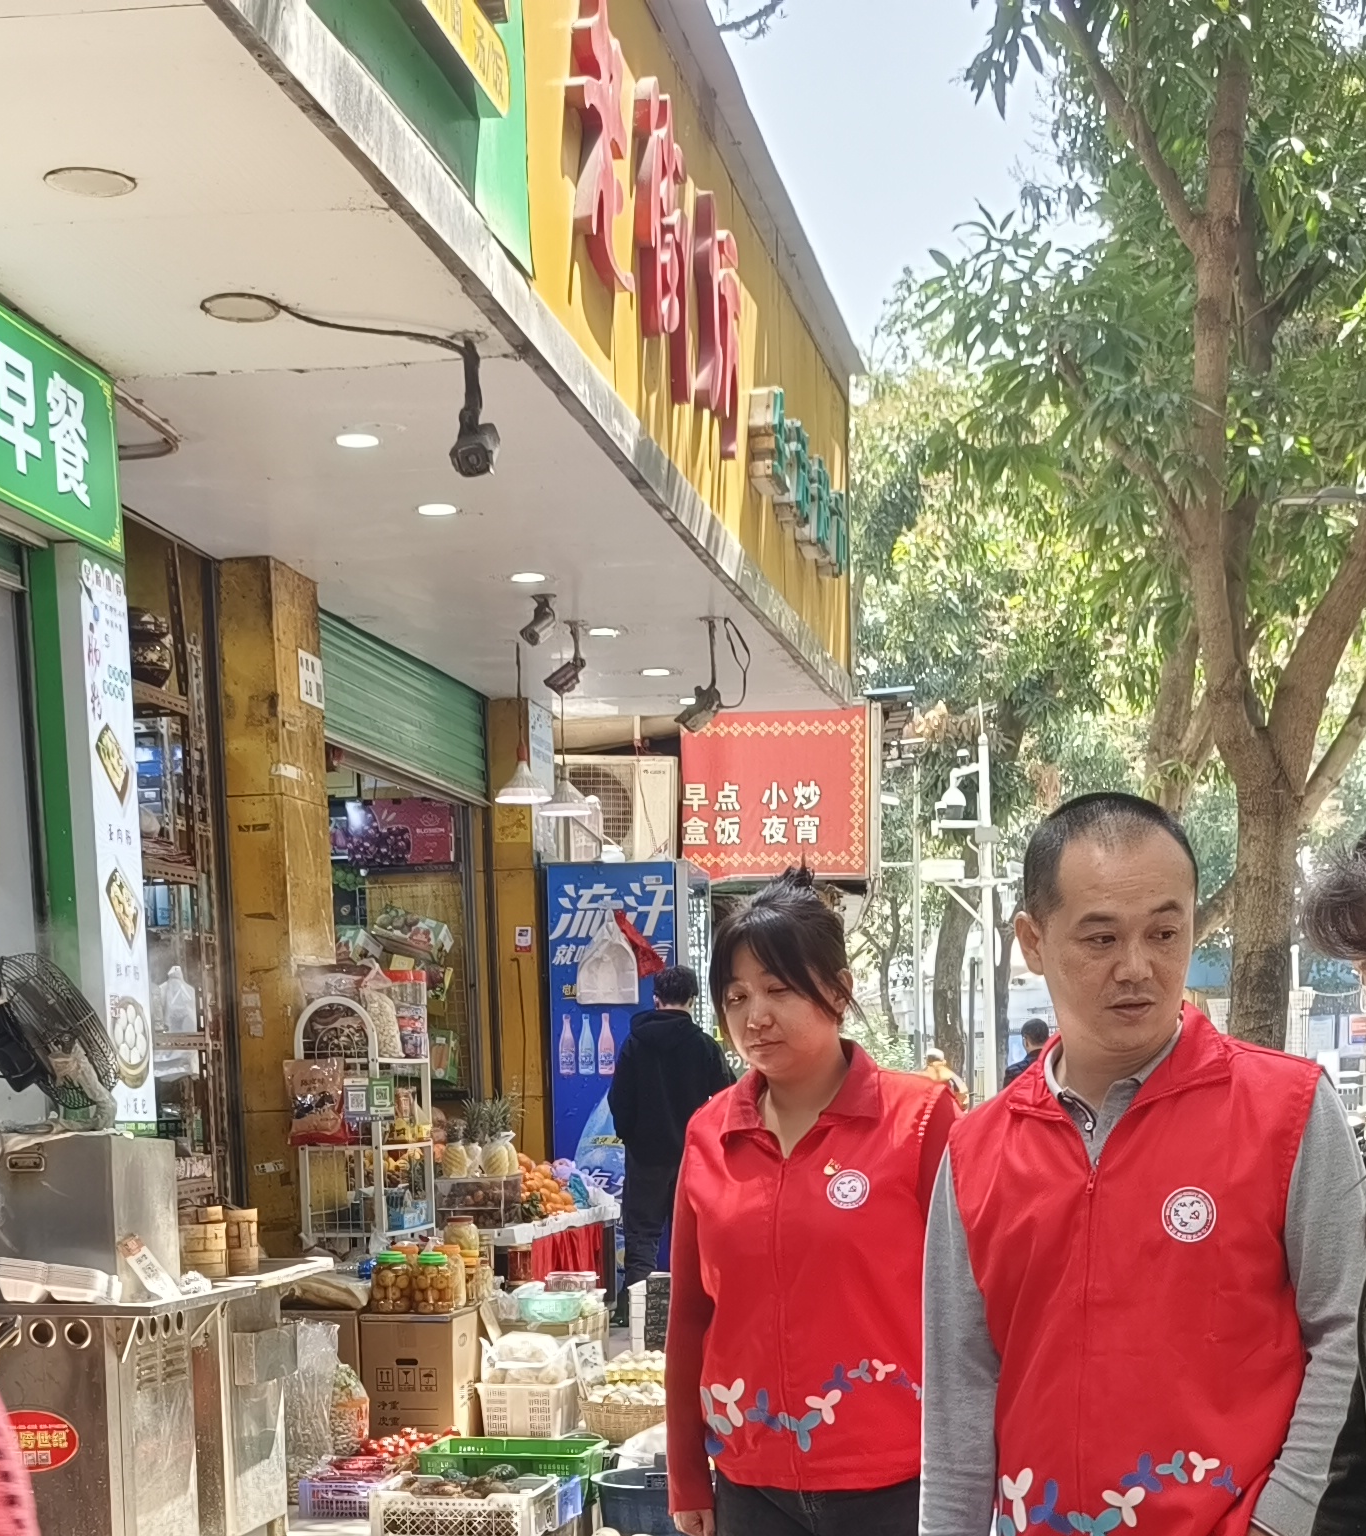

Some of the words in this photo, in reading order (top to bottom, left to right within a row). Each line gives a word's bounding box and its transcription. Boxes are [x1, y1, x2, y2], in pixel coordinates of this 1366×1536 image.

[682, 784, 741, 812] 早点
[761, 781, 821, 811] 小炒
[682, 817, 741, 846] 盒饭
[761, 816, 821, 845] 夜宵
[378, 1401, 399, 1410] 净重
[378, 1416, 400, 1426] 皮重
